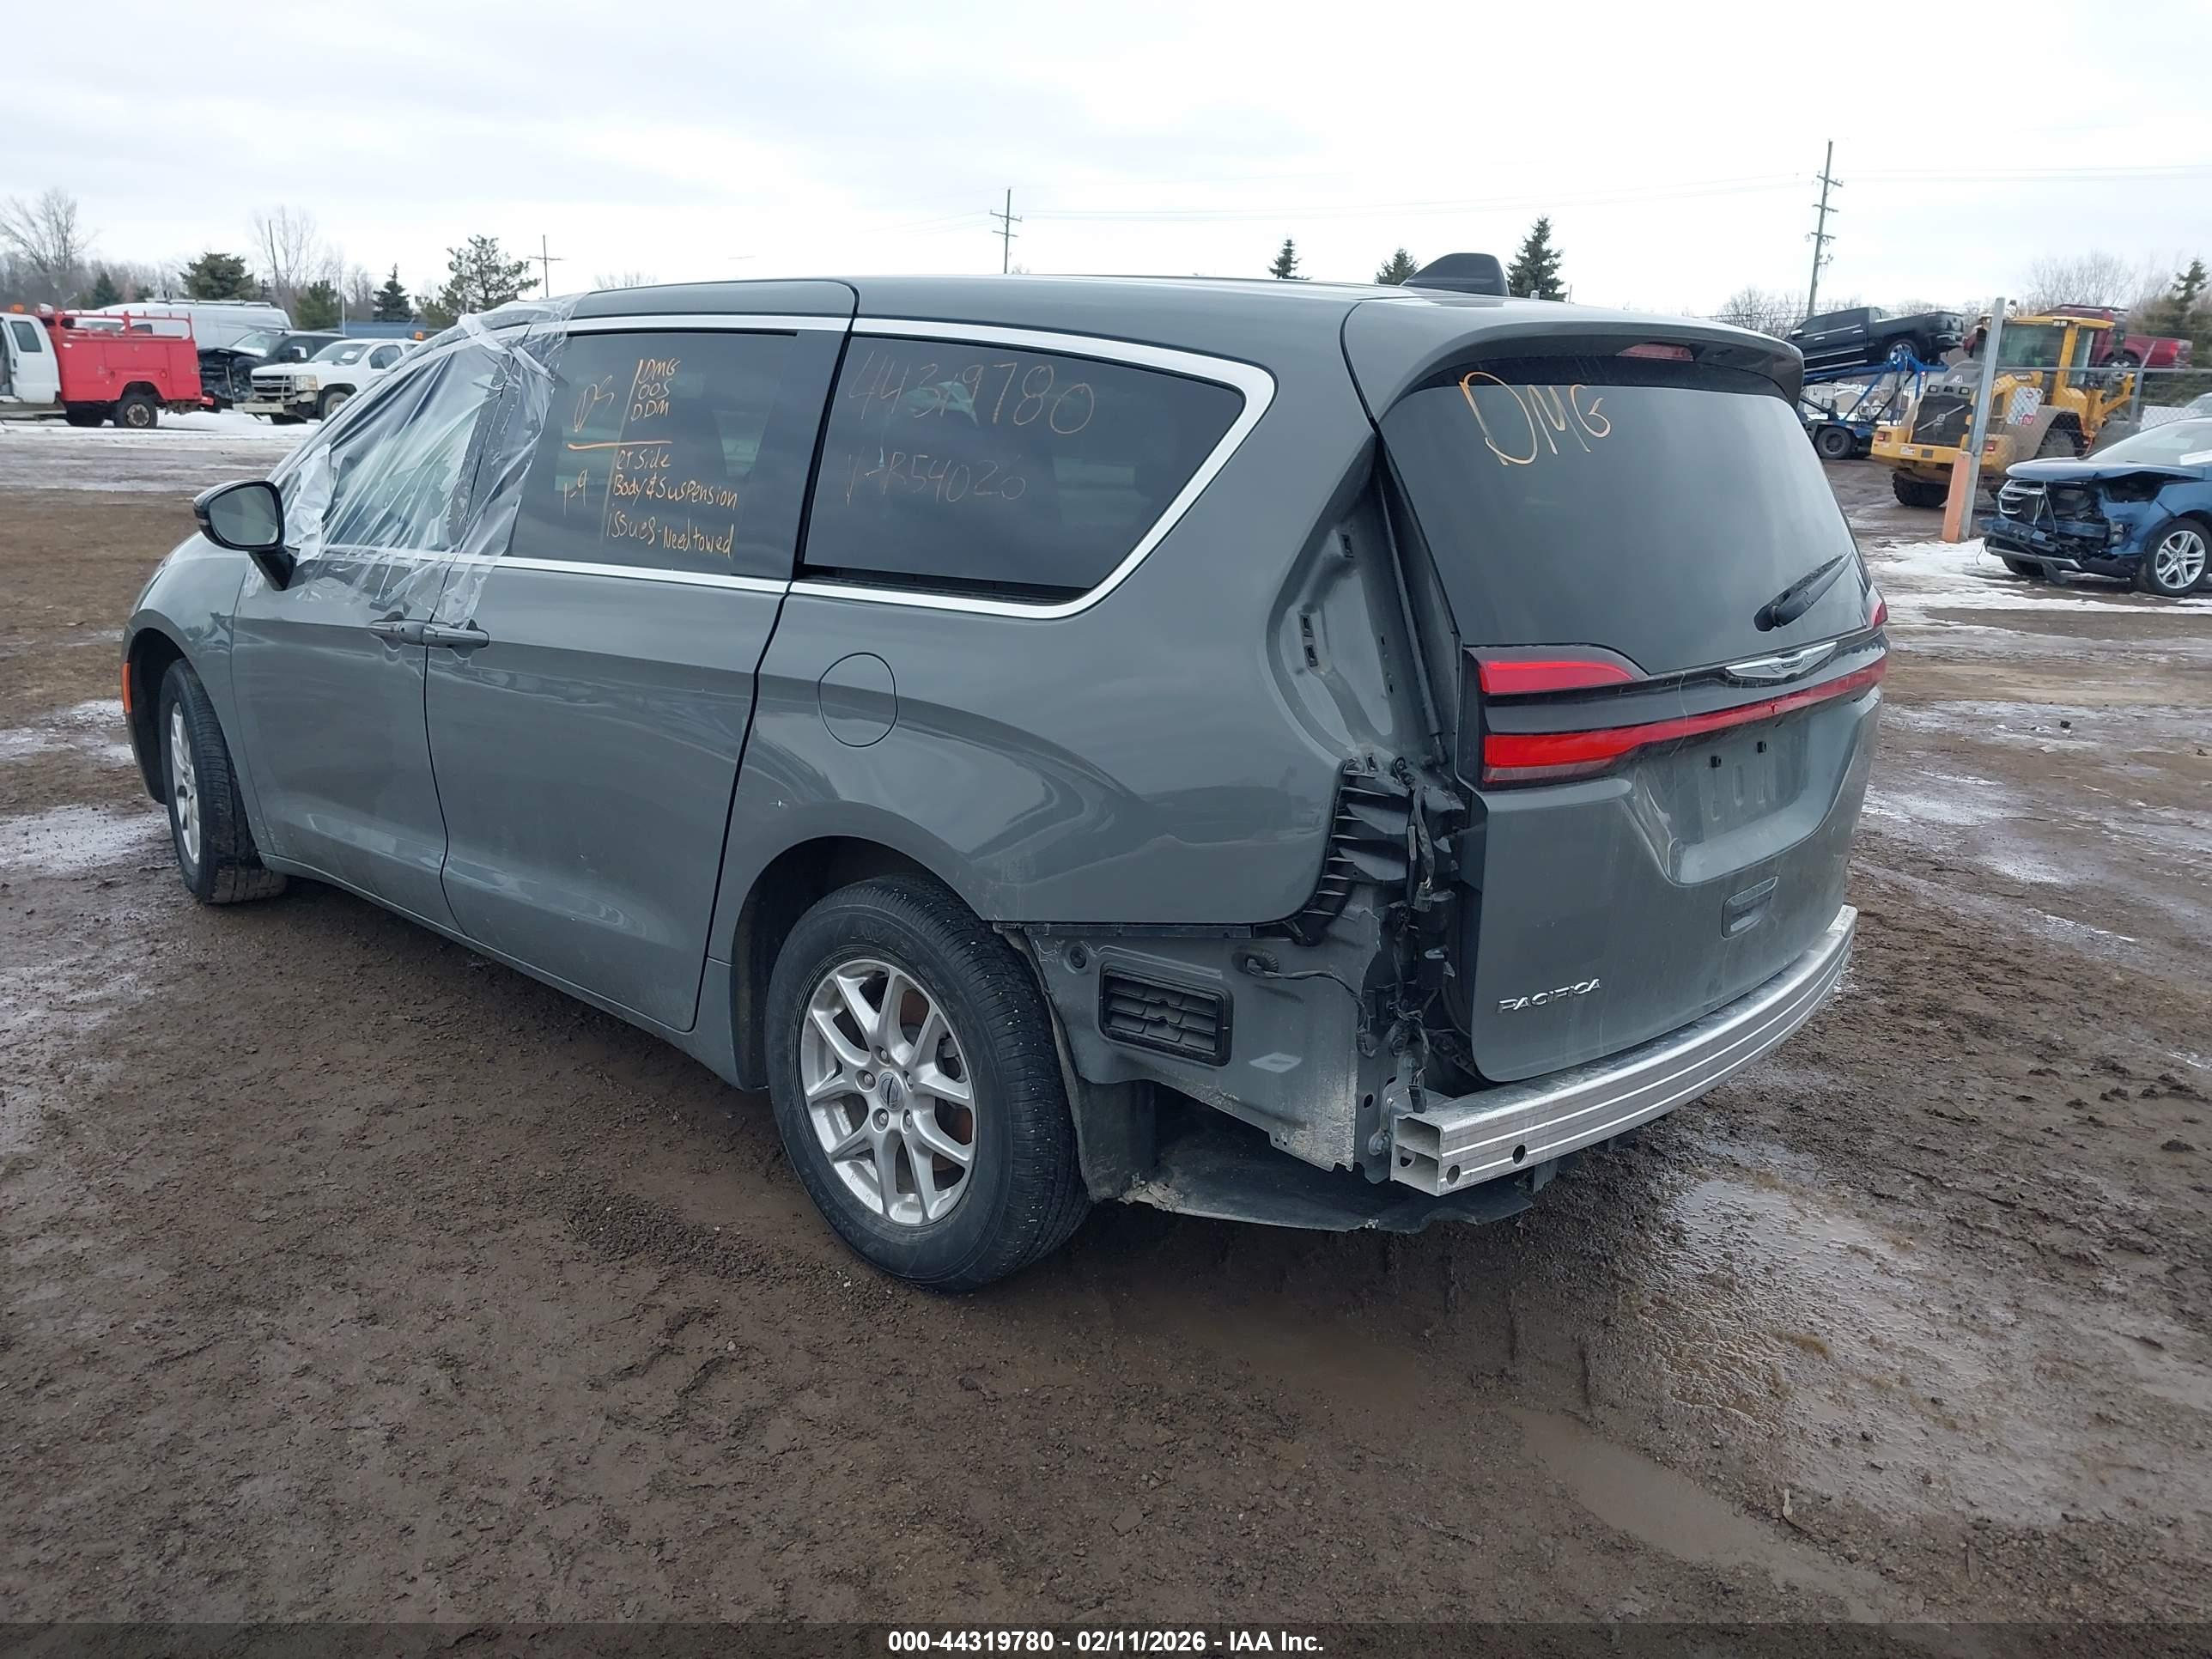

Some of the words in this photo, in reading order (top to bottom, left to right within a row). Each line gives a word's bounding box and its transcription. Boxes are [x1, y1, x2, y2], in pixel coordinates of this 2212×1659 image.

[638, 357, 681, 384] DMG
[630, 398, 670, 422] DDM
[1458, 370, 1612, 465] DMG
[662, 517, 691, 552] Need
[692, 522, 735, 560] towed
[1497, 978, 1601, 1013] PACIFICA
